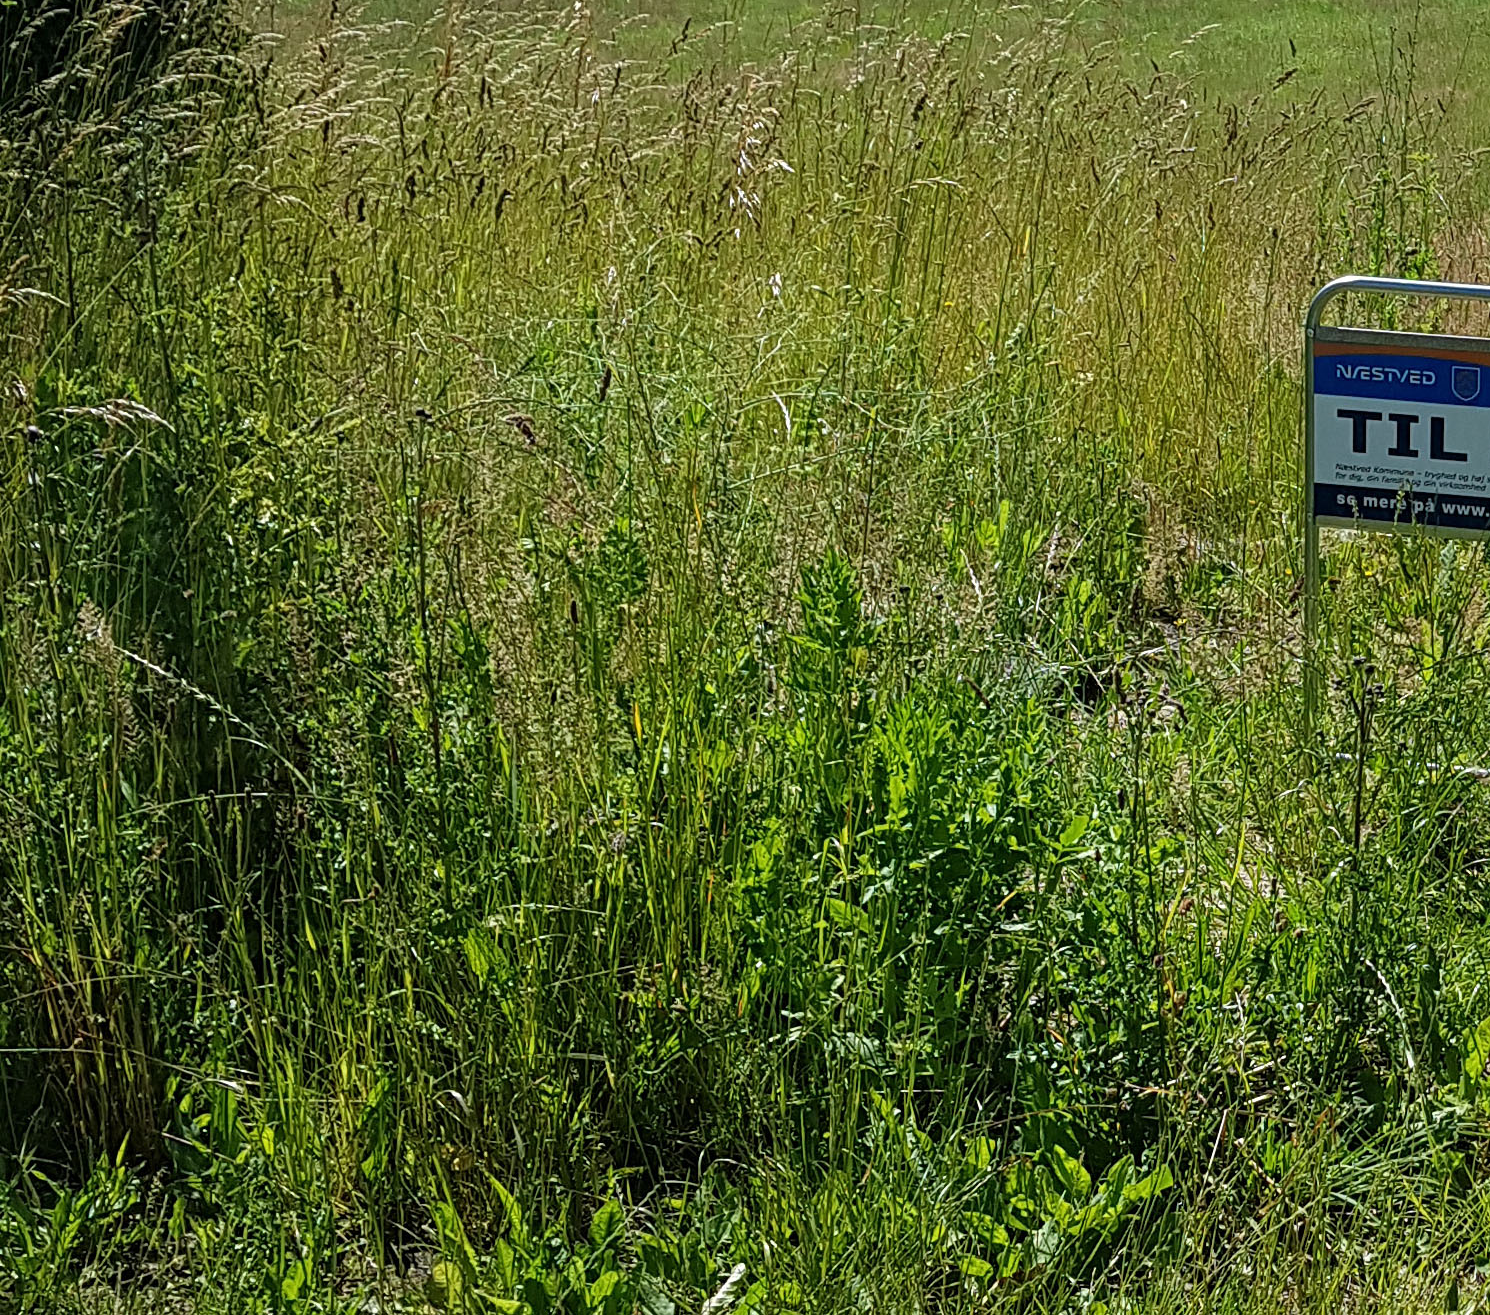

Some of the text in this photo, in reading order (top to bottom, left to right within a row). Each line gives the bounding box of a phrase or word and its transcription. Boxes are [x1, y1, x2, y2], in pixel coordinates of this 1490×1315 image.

[1336, 364, 1436, 385] NÆSTVED
[1336, 409, 1468, 462] TIL
[1335, 471, 1347, 480] for
[1336, 493, 1357, 505] se
[1363, 496, 1407, 510] mere
[1413, 497, 1435, 514] på
